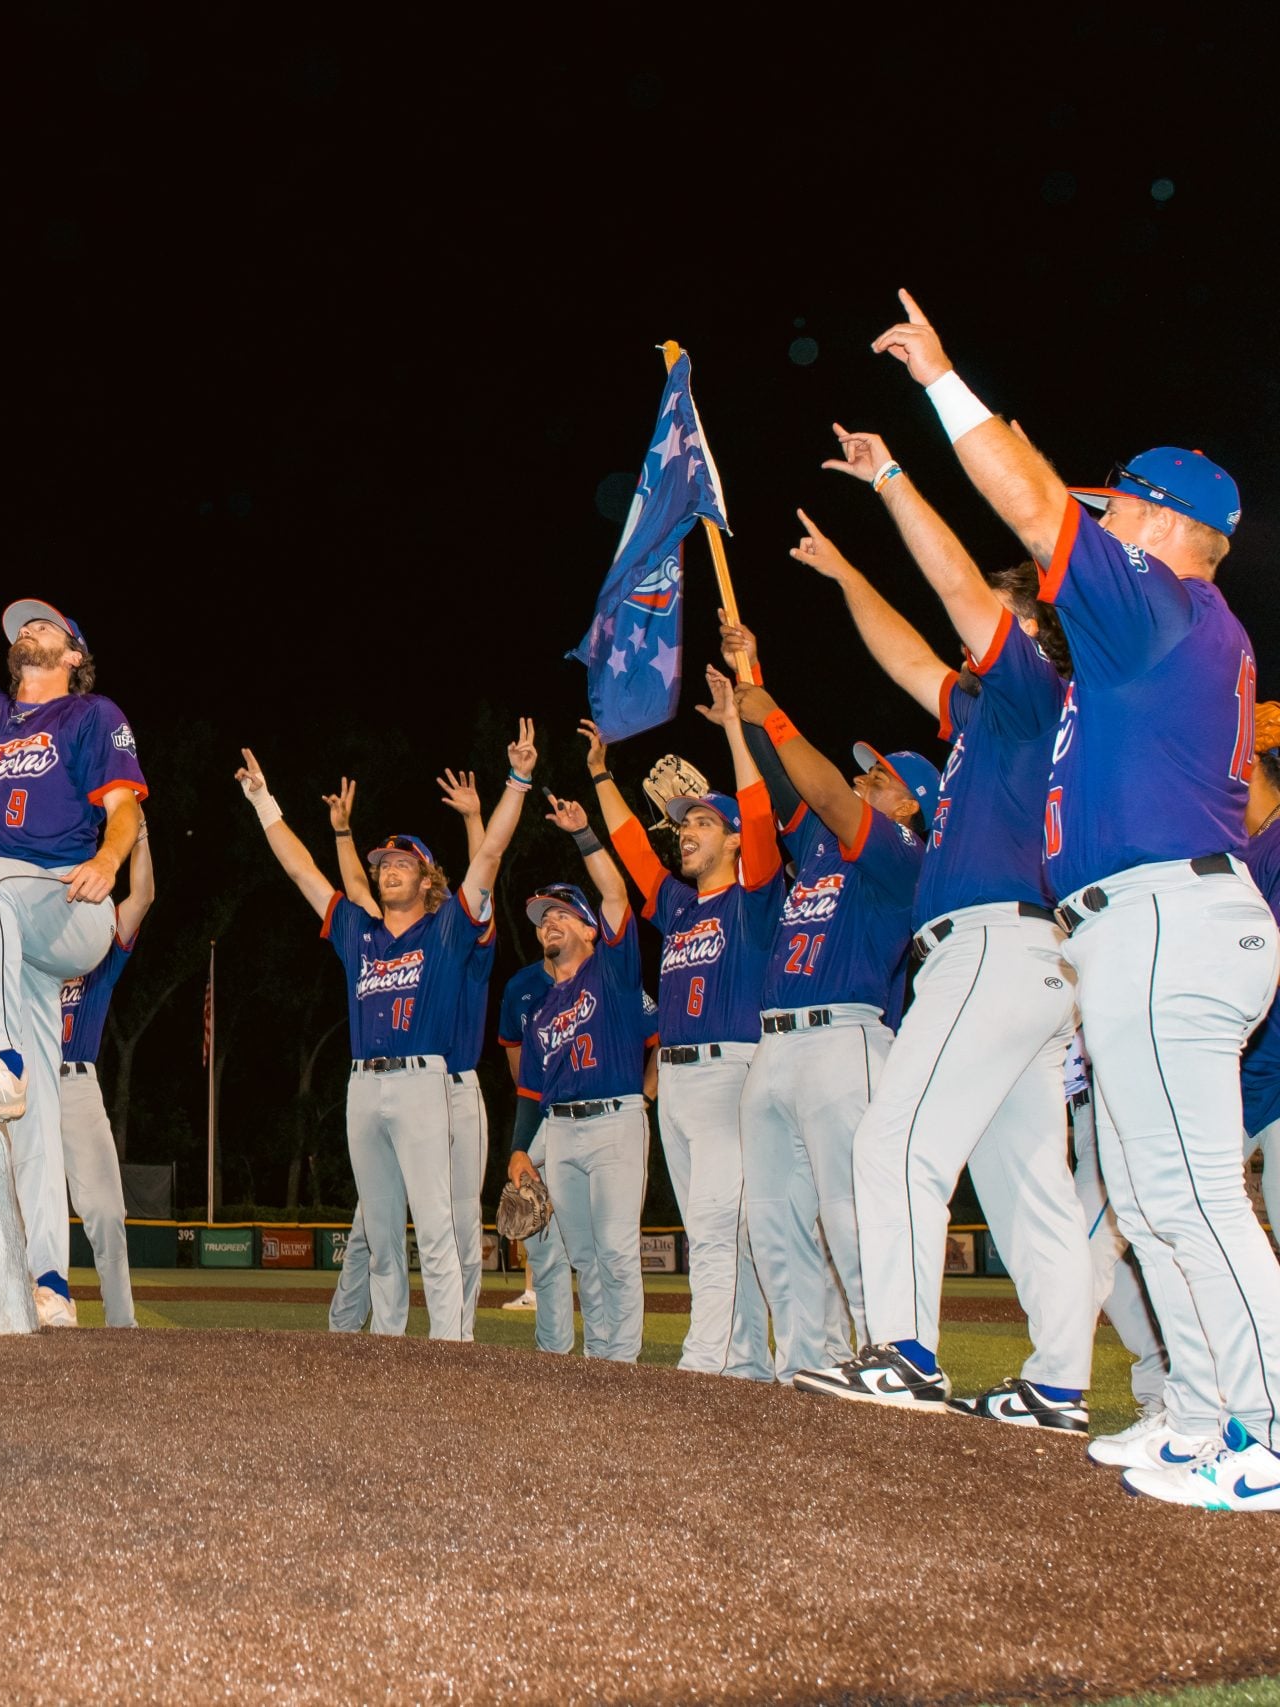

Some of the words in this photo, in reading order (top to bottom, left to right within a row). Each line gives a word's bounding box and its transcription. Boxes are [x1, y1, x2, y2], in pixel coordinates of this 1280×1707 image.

[6, 789, 28, 828] 9
[687, 976, 705, 1017] 6
[570, 1033, 597, 1071] 12
[177, 1229, 195, 1241] 395
[204, 1242, 248, 1252] TRUGREEN
